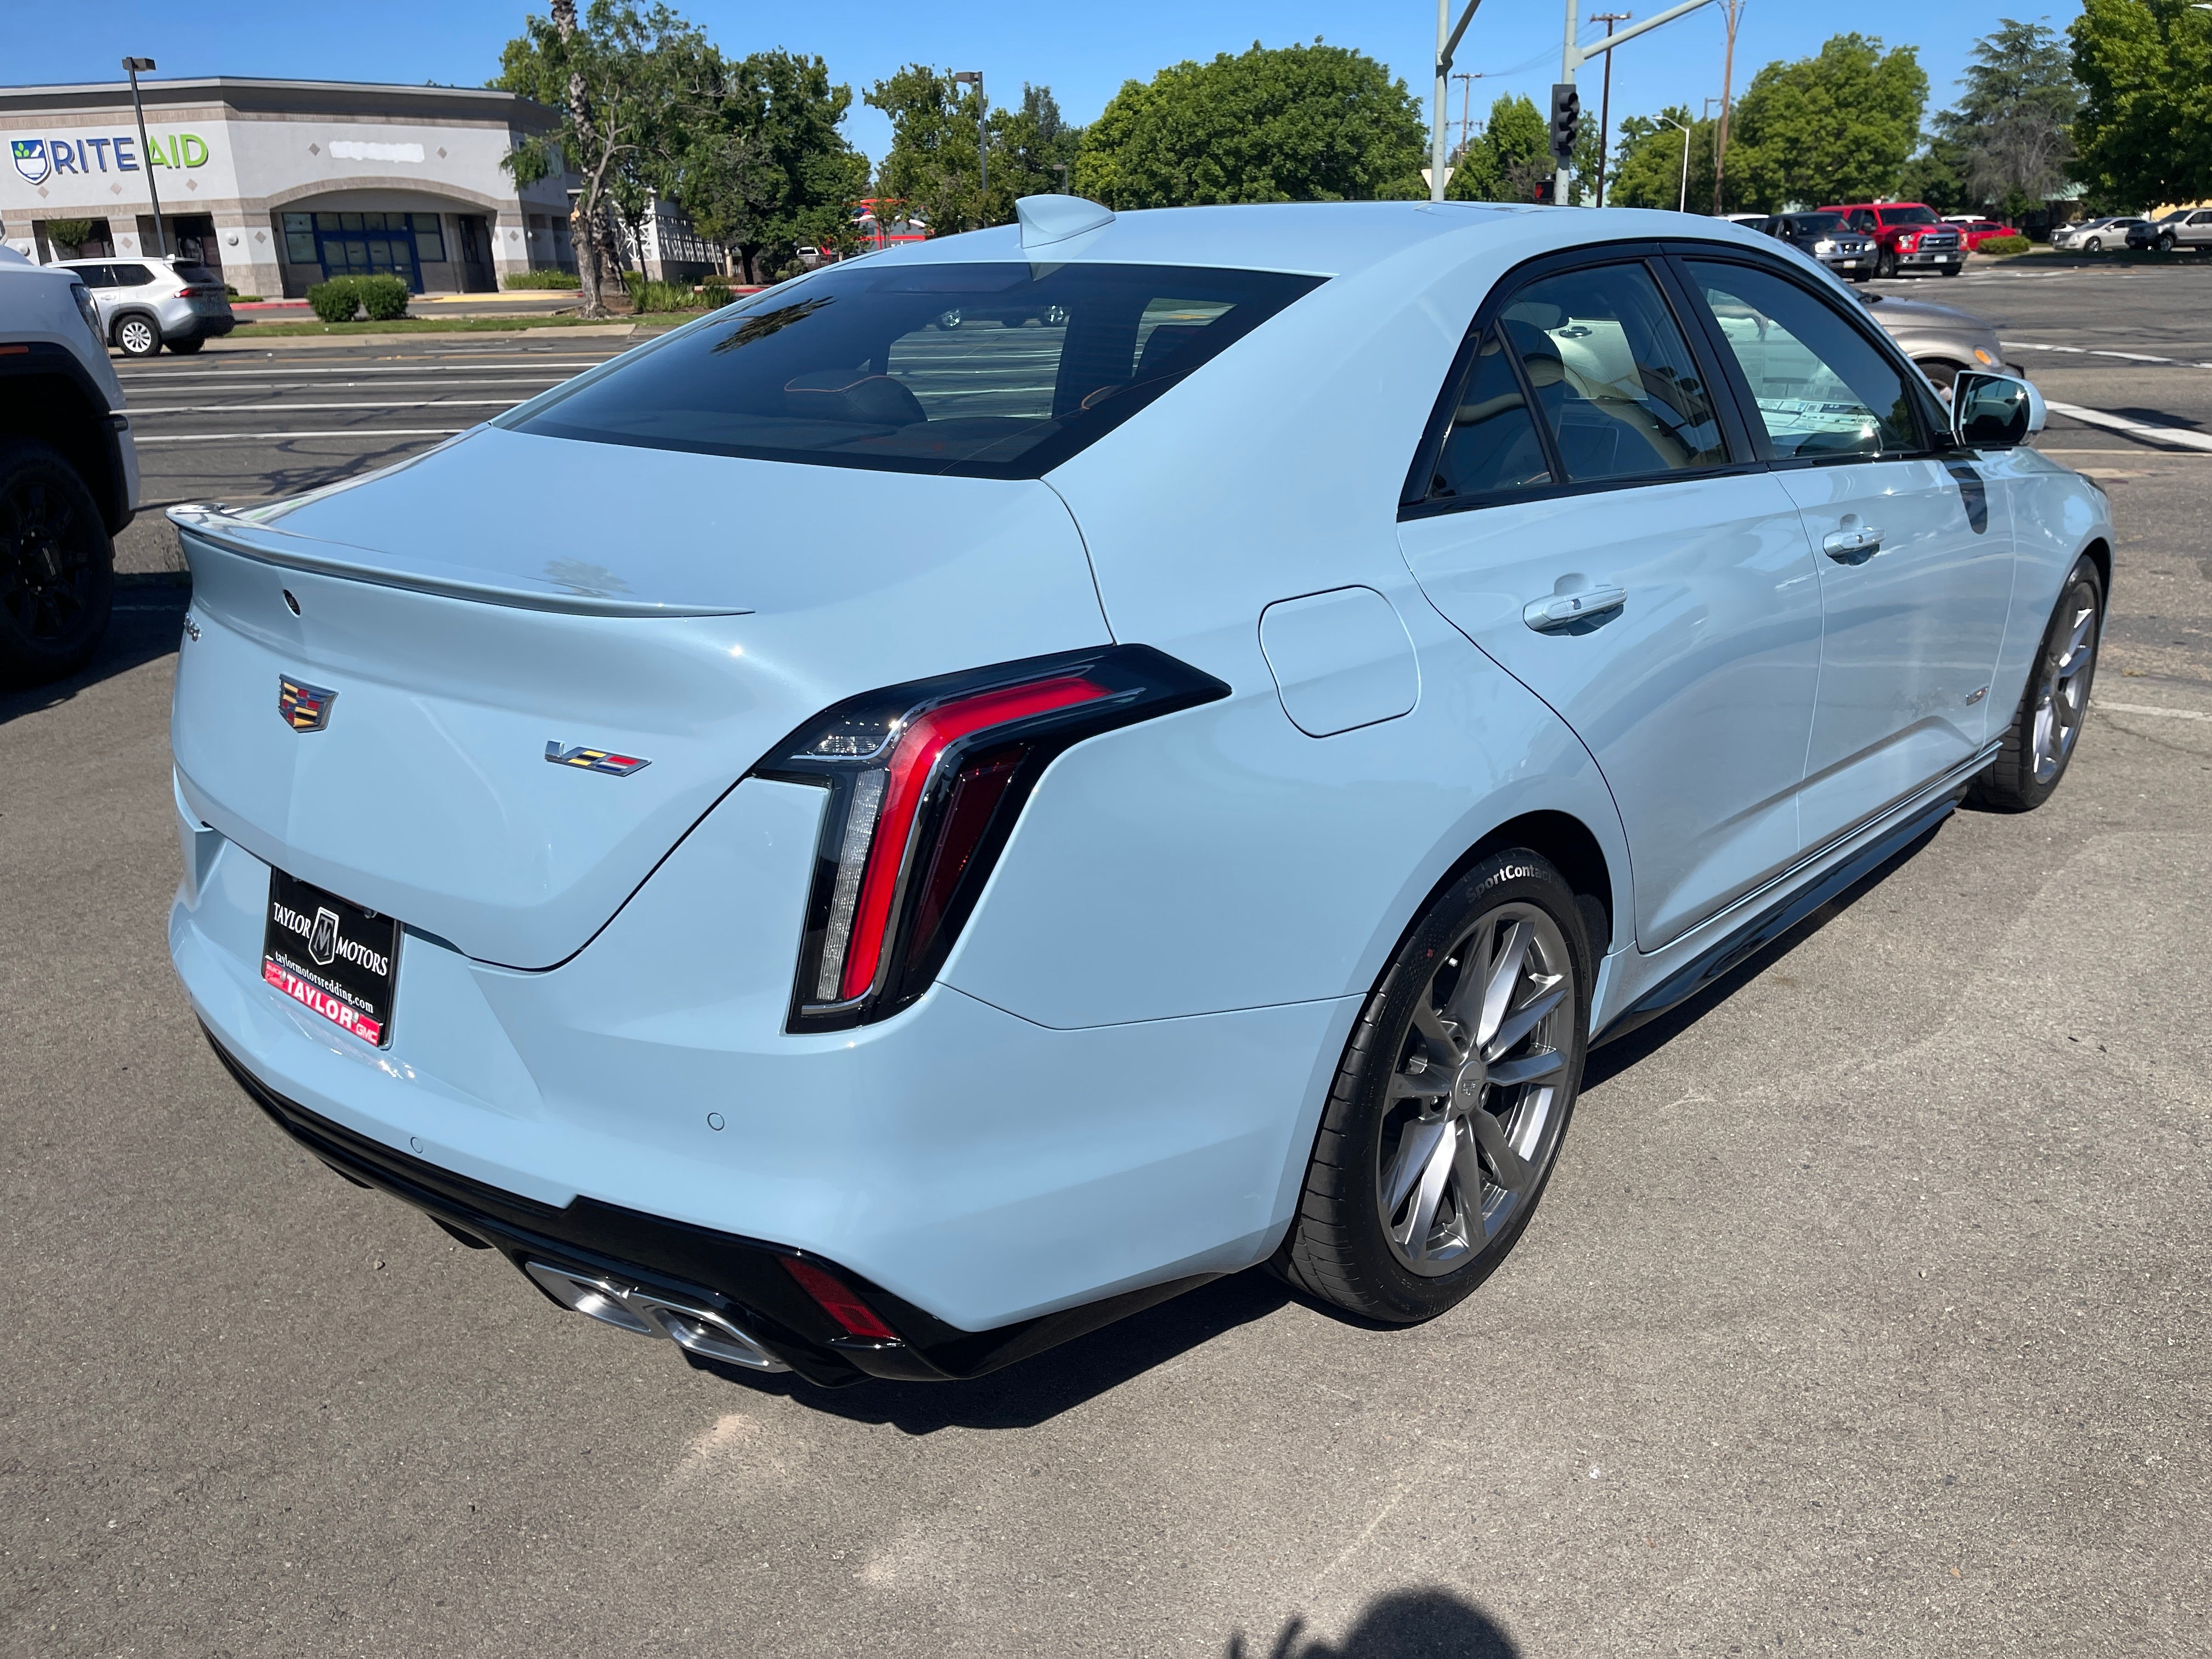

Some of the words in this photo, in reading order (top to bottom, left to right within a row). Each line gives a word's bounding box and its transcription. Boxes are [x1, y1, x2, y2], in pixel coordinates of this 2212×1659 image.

[50, 137, 140, 174] RITE
[148, 133, 208, 170] AID
[274, 902, 311, 939] TAYLOR
[335, 936, 388, 977] MOTORS
[275, 951, 374, 1014] taylormotorsredding.com
[286, 973, 352, 1029] TAYLOR
[356, 1023, 378, 1043] GMC
